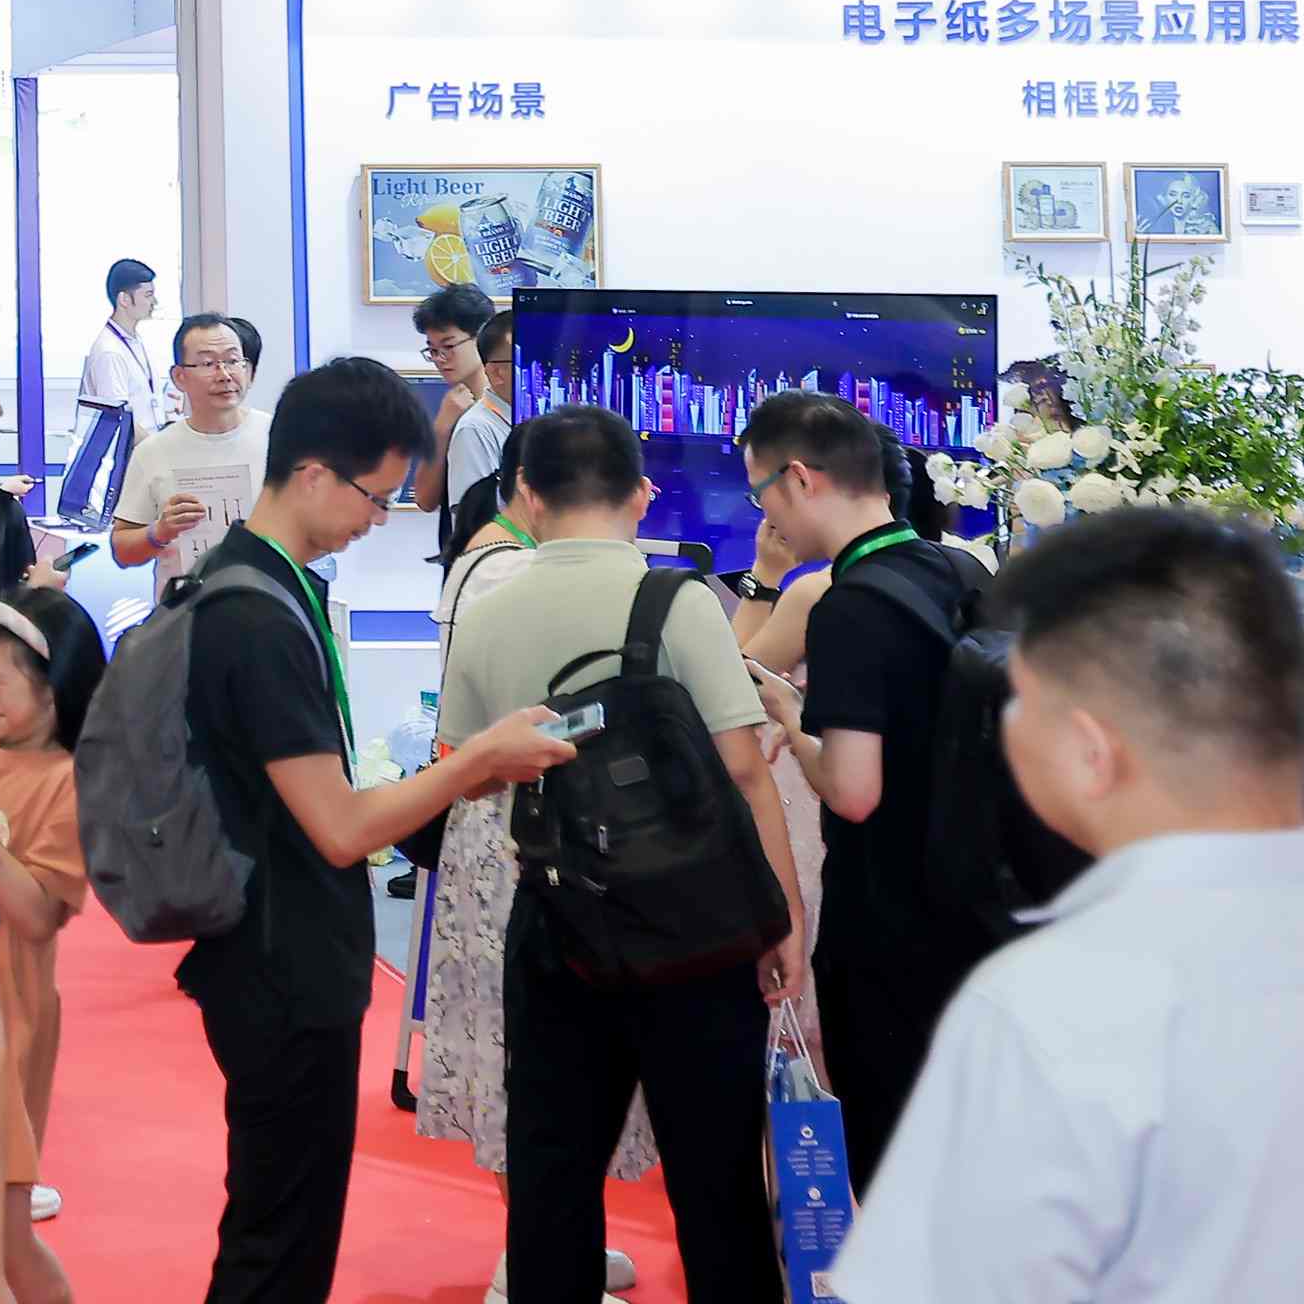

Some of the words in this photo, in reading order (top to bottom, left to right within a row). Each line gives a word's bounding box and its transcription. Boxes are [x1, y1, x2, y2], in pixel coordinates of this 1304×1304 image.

[842, 0, 1301, 43] 电子纸多场景应用展
[385, 82, 546, 120] 广告场景
[1022, 79, 1182, 117] 相框场景
[373, 178, 429, 200] Light
[436, 178, 485, 196] Beer
[543, 209, 582, 233] BEER
